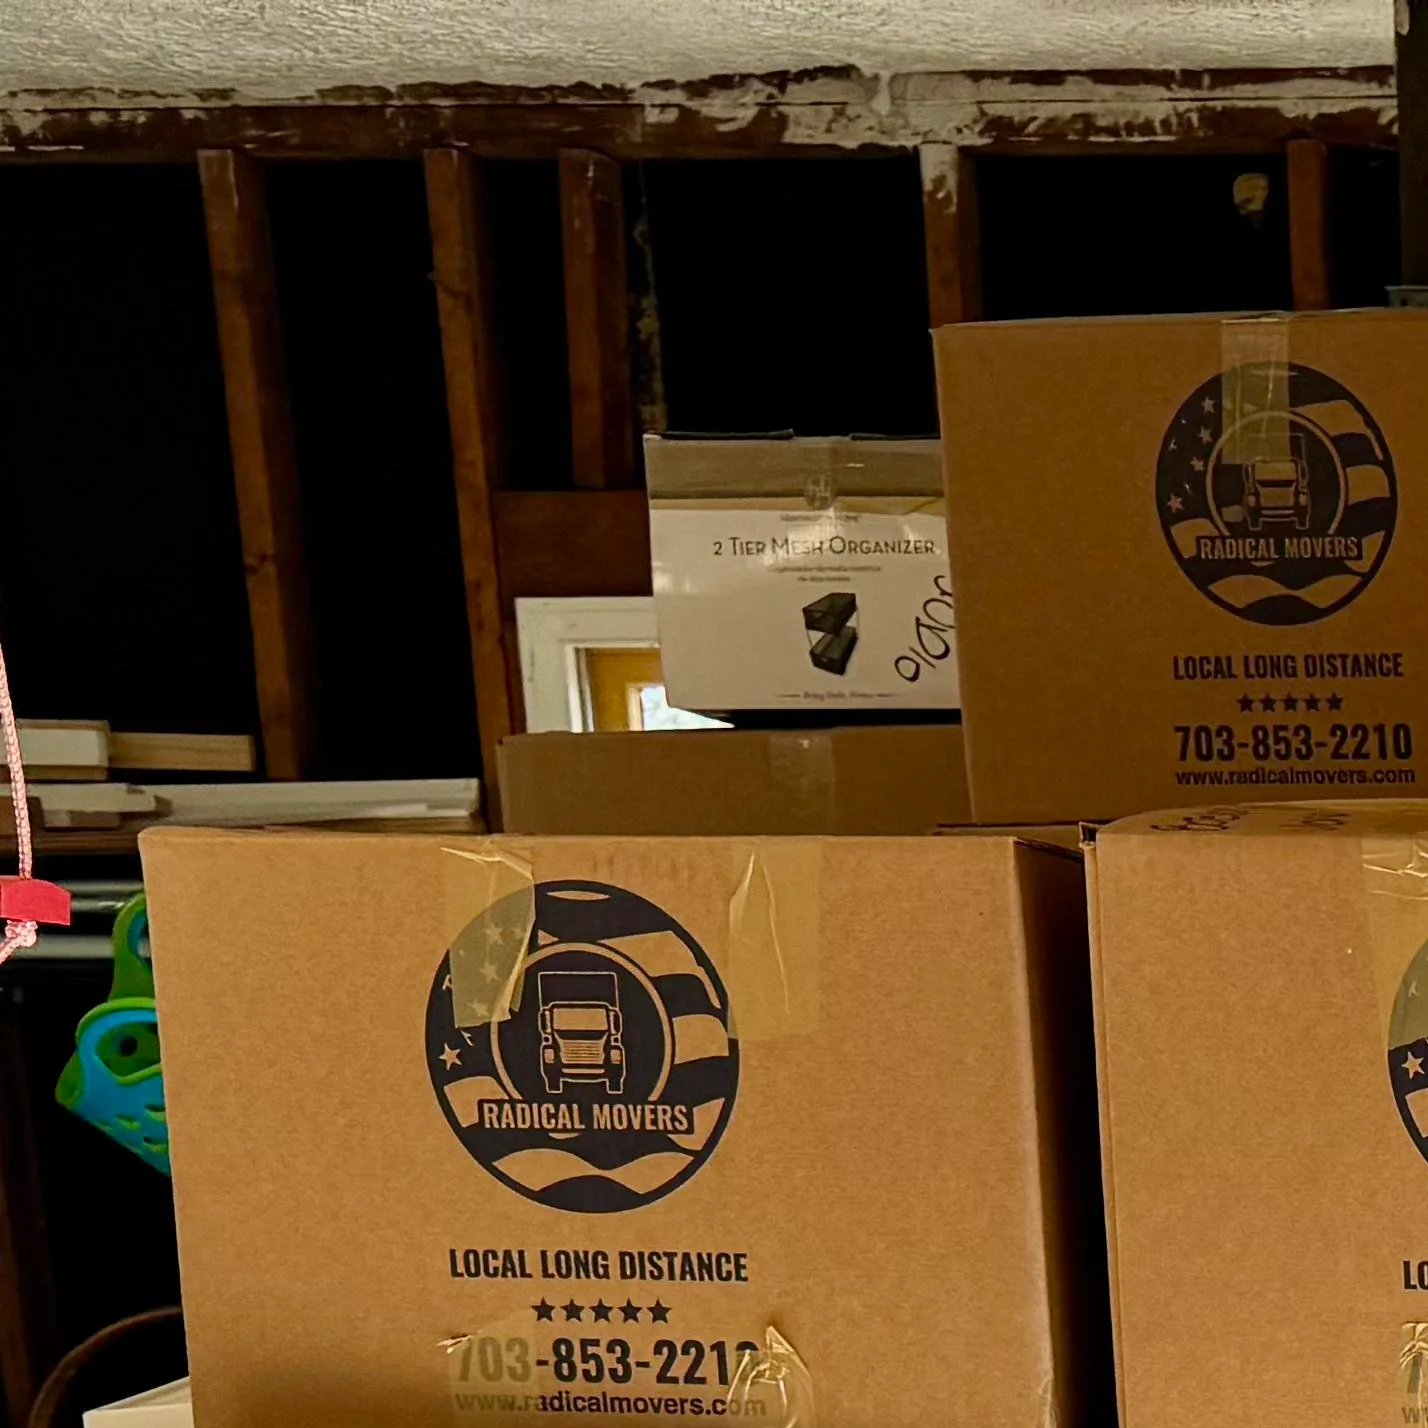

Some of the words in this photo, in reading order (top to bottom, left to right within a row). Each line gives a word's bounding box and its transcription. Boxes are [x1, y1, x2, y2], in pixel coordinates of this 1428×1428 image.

[713, 541, 723, 556] 2
[1200, 537, 1279, 560] RADICAL
[1284, 536, 1358, 558] MOVERS
[1173, 656, 1237, 680] LOCAL
[1244, 655, 1297, 678] LONG
[1304, 653, 1404, 678] DISTANCE
[1173, 724, 1412, 762] 703-853-2210
[1176, 767, 1415, 785] www.radicalmovers.com
[483, 1102, 585, 1130] RADICAL
[593, 1104, 689, 1132] MOVERS
[449, 1248, 532, 1279] LOCAL
[540, 1250, 611, 1280] LONG
[619, 1252, 748, 1282] DISTANCE
